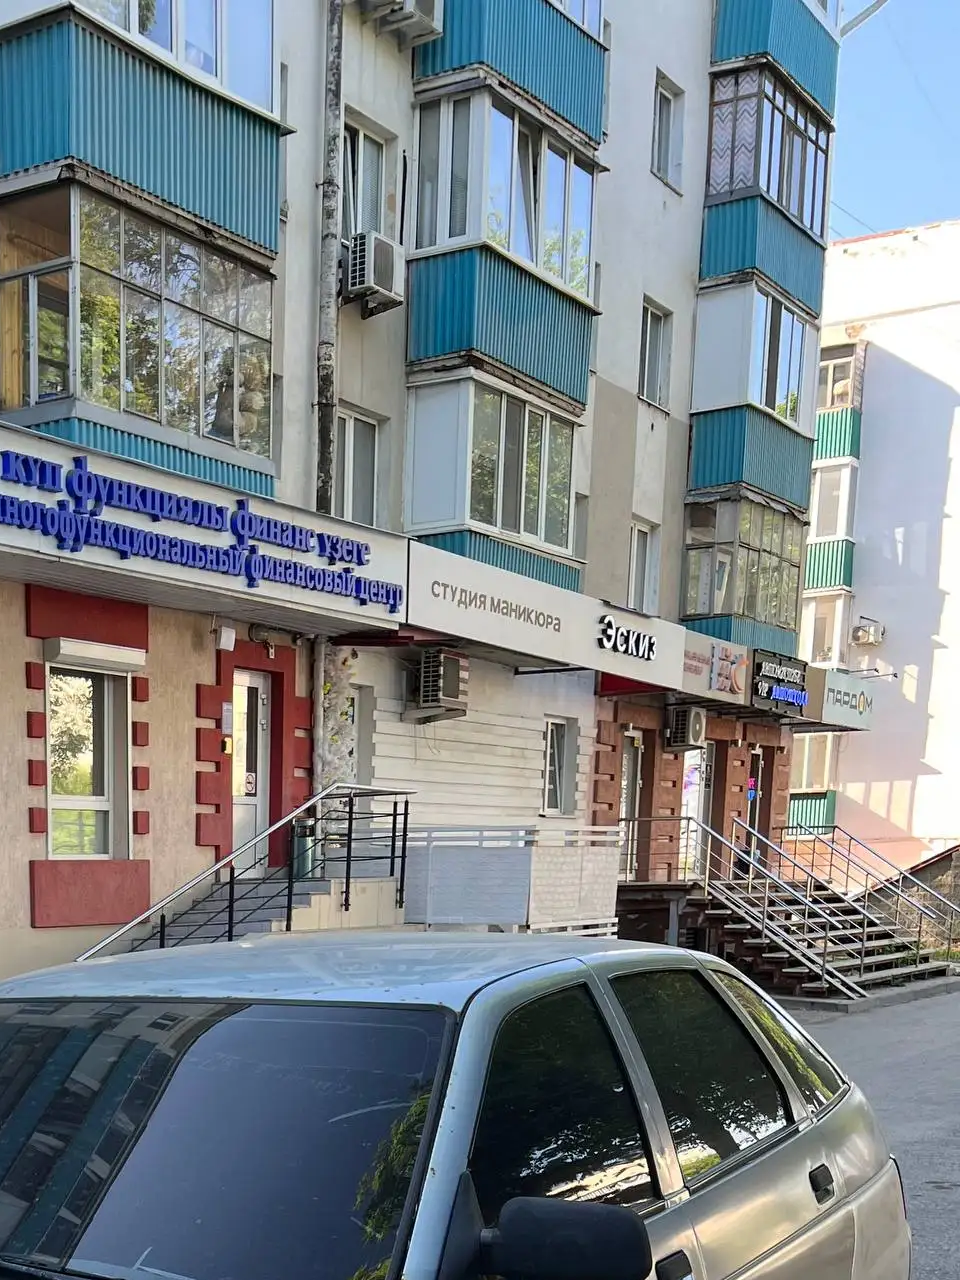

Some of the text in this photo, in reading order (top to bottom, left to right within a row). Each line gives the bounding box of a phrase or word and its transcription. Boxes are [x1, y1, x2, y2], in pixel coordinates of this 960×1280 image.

[65, 456, 230, 533] функциялы
[230, 498, 316, 553] финанс
[244, 545, 358, 599] финансовый
[354, 577, 404, 614] центр
